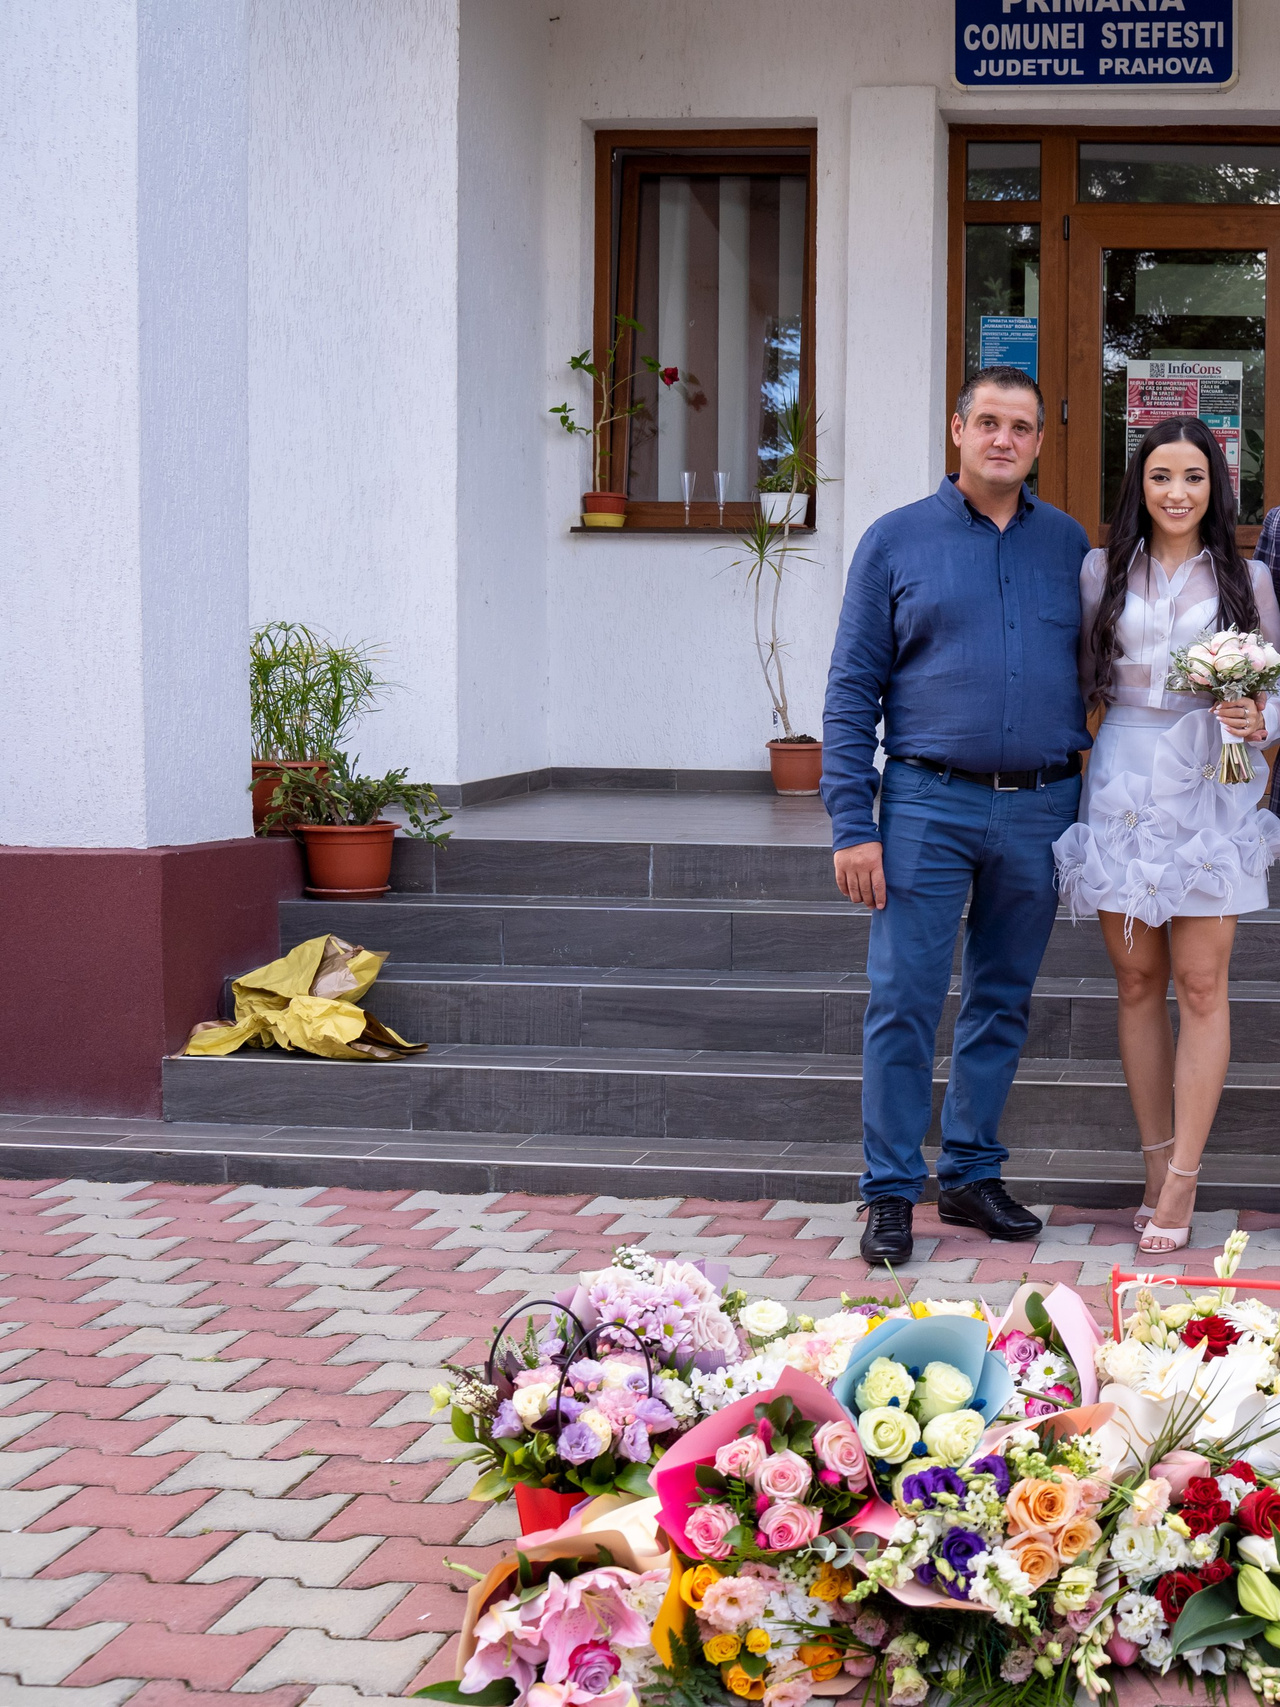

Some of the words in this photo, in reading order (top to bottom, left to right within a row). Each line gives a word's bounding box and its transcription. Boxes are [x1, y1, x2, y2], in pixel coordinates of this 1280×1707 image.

[963, 23, 1085, 50] COMUNEI
[1101, 21, 1224, 49] STEFESTI
[973, 59, 1084, 77] JUDETUL
[1099, 57, 1214, 76] PRAHOVA
[1168, 362, 1222, 374] InfoCons
